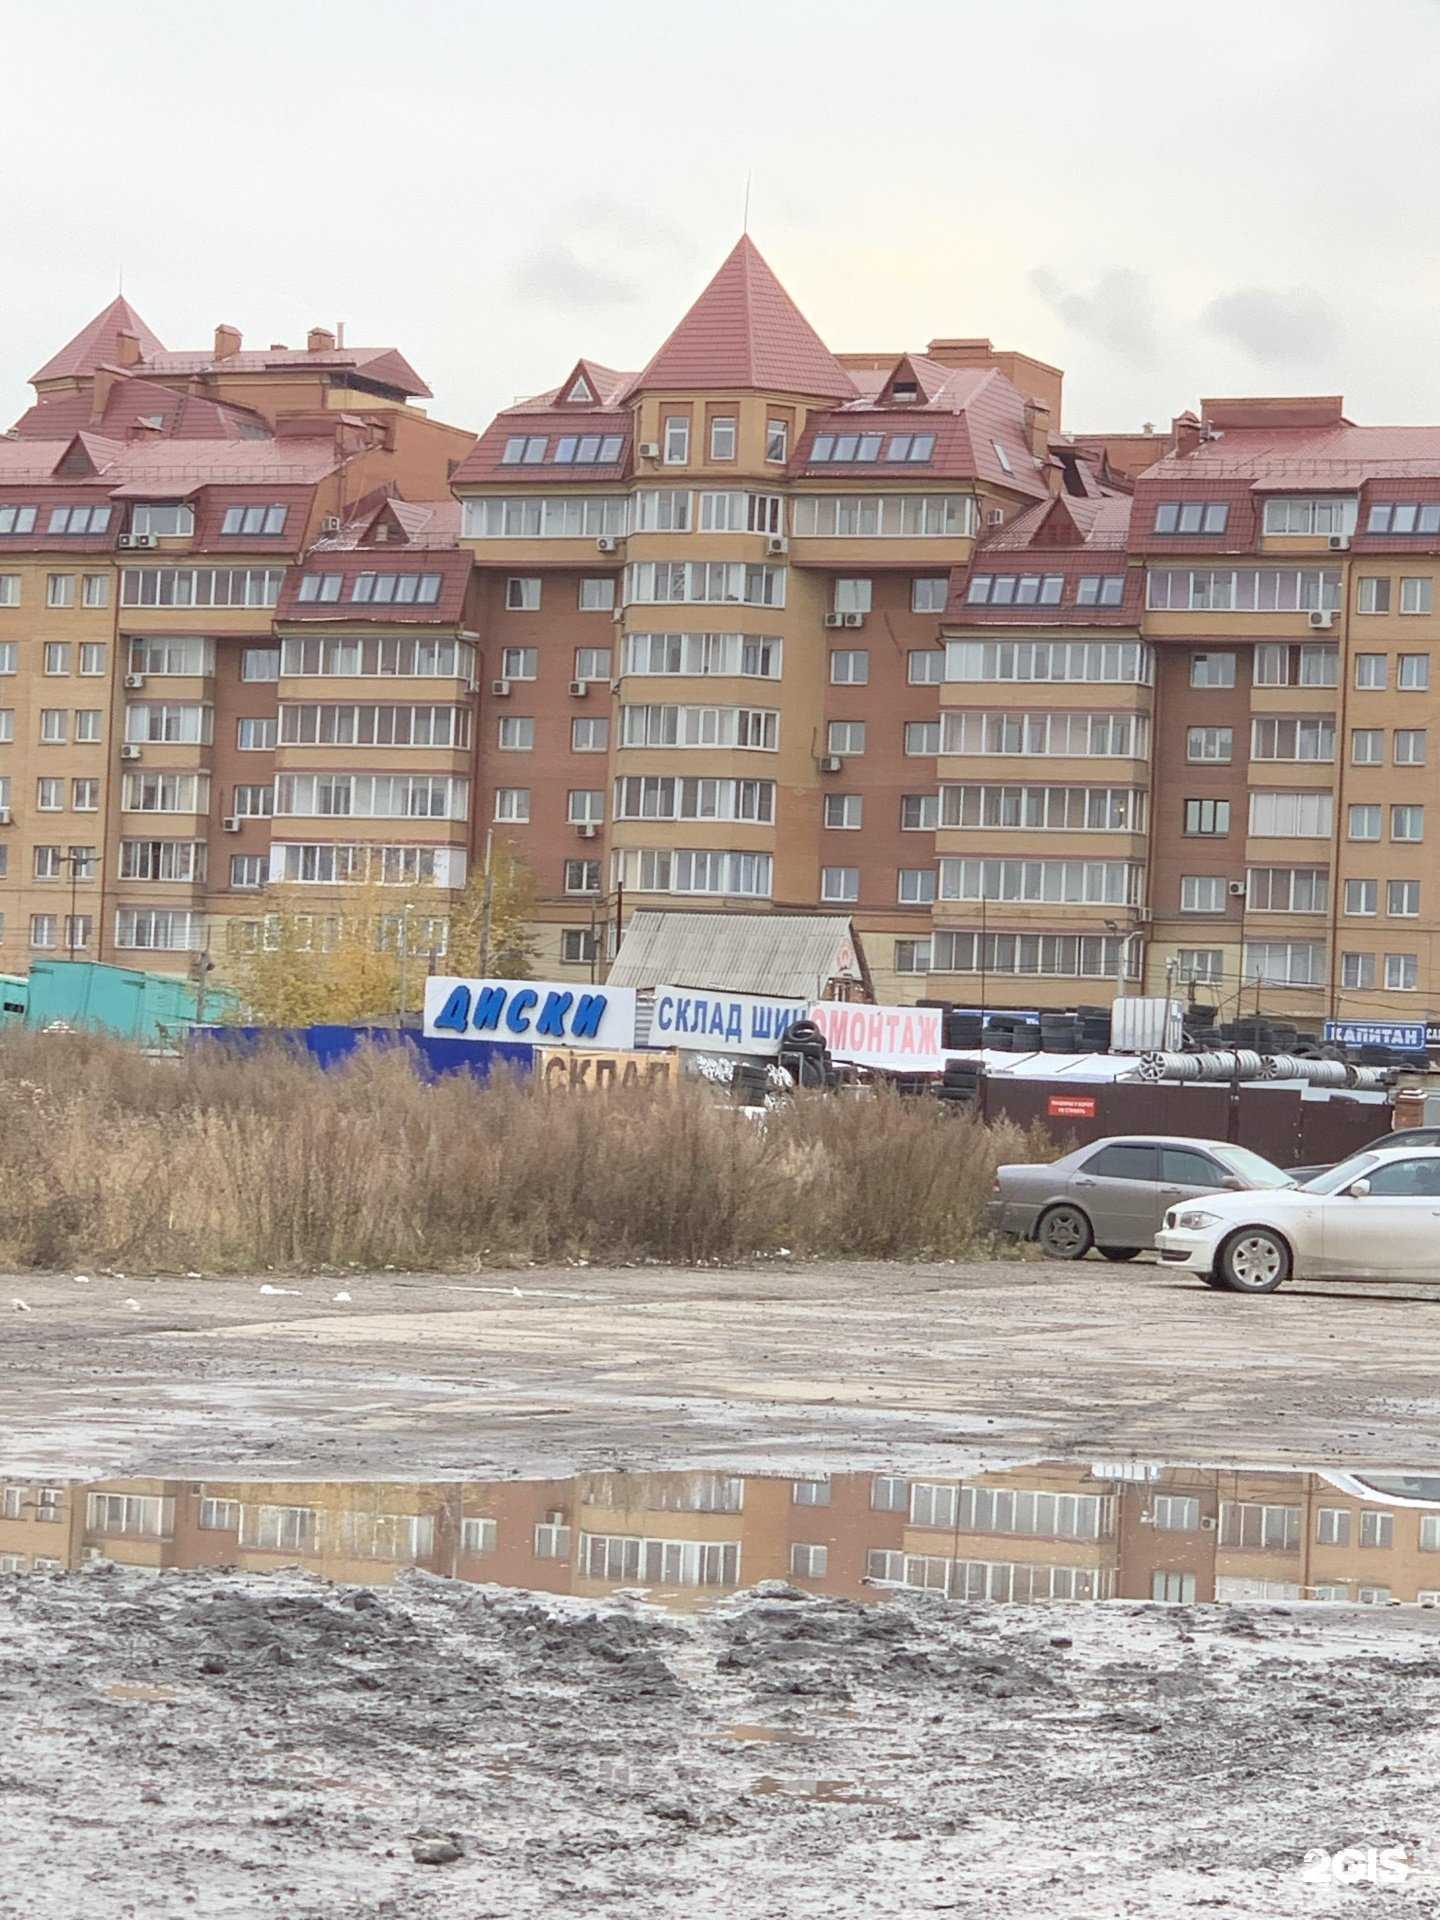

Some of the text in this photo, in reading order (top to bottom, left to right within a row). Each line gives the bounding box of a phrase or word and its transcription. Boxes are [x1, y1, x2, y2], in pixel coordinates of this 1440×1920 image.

[433, 984, 608, 1040] ДИСКИ
[658, 995, 743, 1043] СКЛАД
[1330, 1026, 1417, 1045] КАПИТАН
